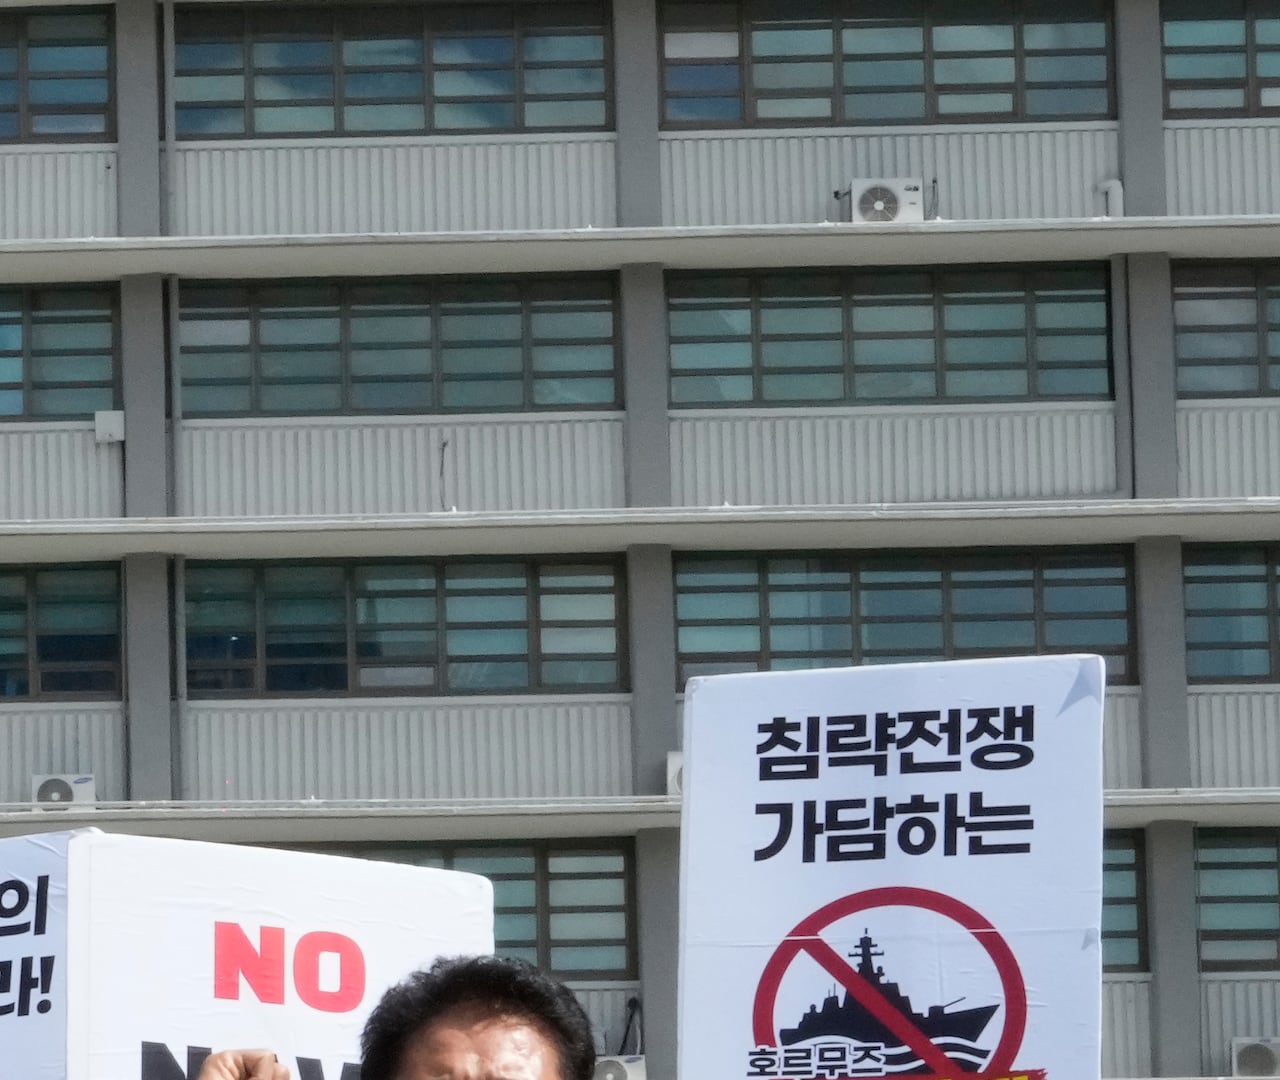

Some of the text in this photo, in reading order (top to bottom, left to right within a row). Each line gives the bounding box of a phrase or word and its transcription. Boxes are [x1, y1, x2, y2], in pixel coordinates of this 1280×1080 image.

[756, 705, 1035, 781] 침략전쟁
[754, 792, 1034, 863] 가담하는
[214, 921, 366, 1013] NO
[746, 1045, 887, 1079] 호르무즈
